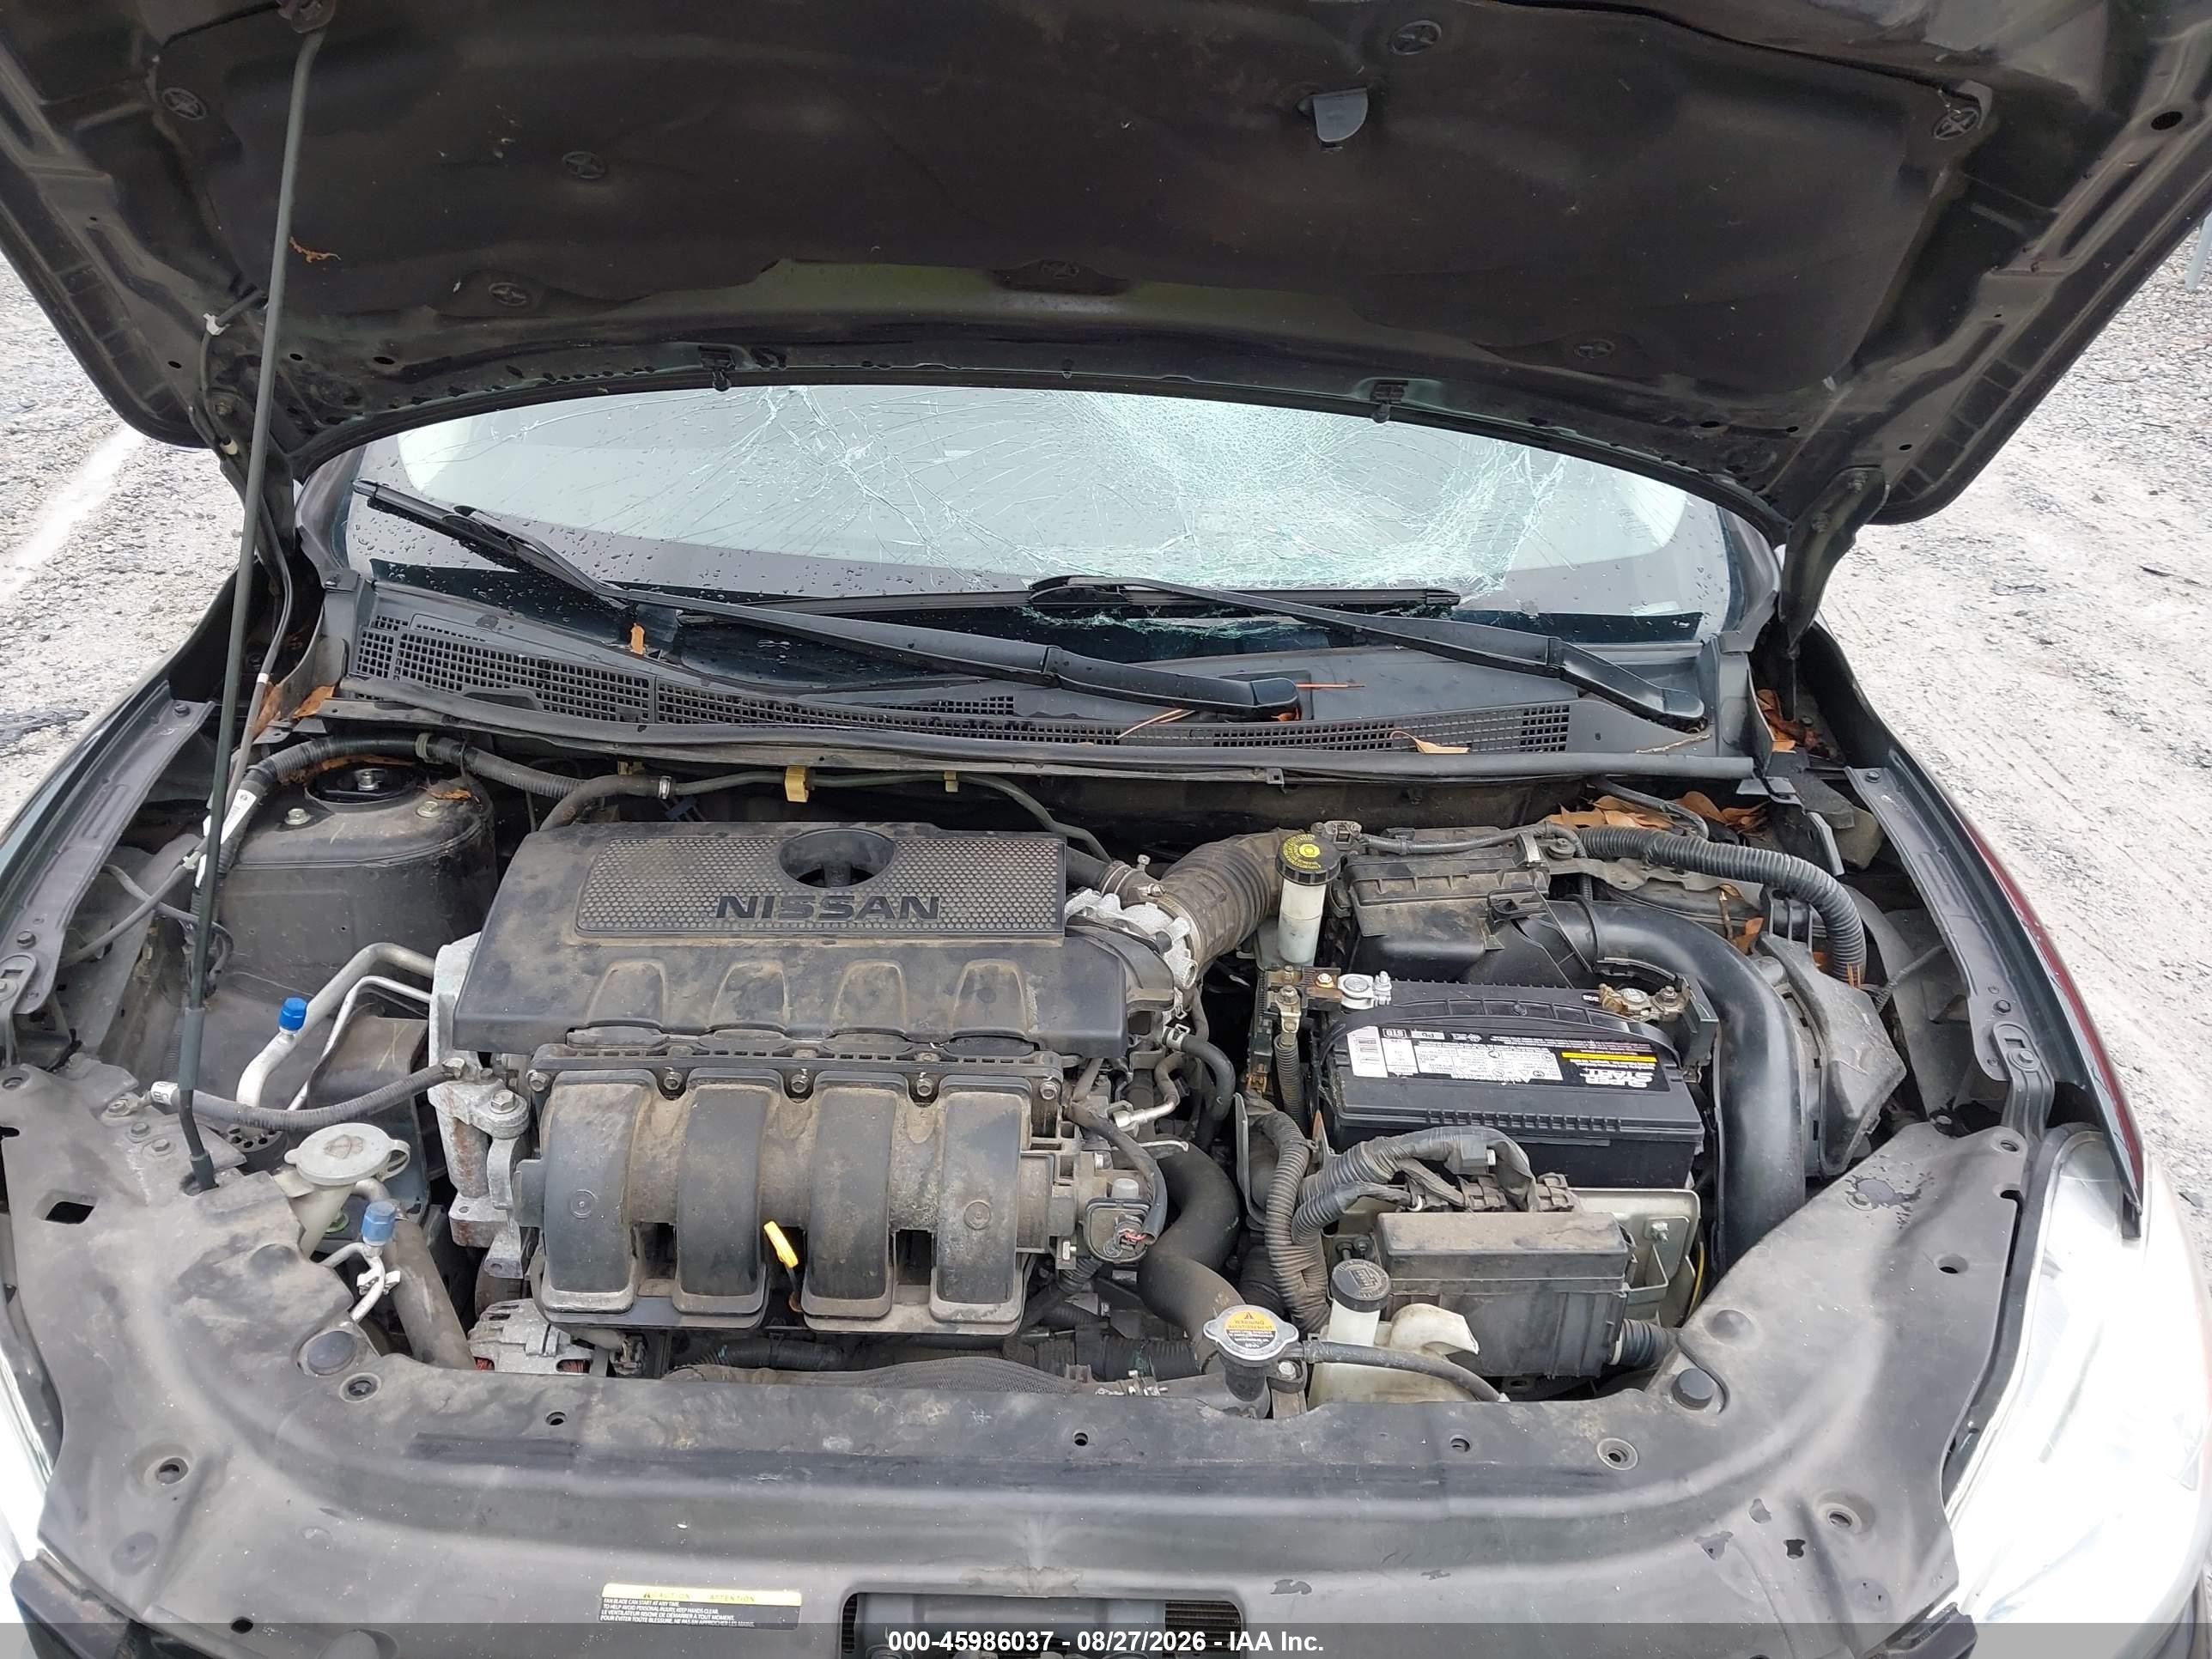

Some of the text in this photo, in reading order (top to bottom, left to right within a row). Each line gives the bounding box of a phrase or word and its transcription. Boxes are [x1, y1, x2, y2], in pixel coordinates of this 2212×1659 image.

[715, 895, 940, 920] NISSAN
[1583, 1069, 1654, 1083] START
[1585, 1077, 1648, 1088] SUPER
